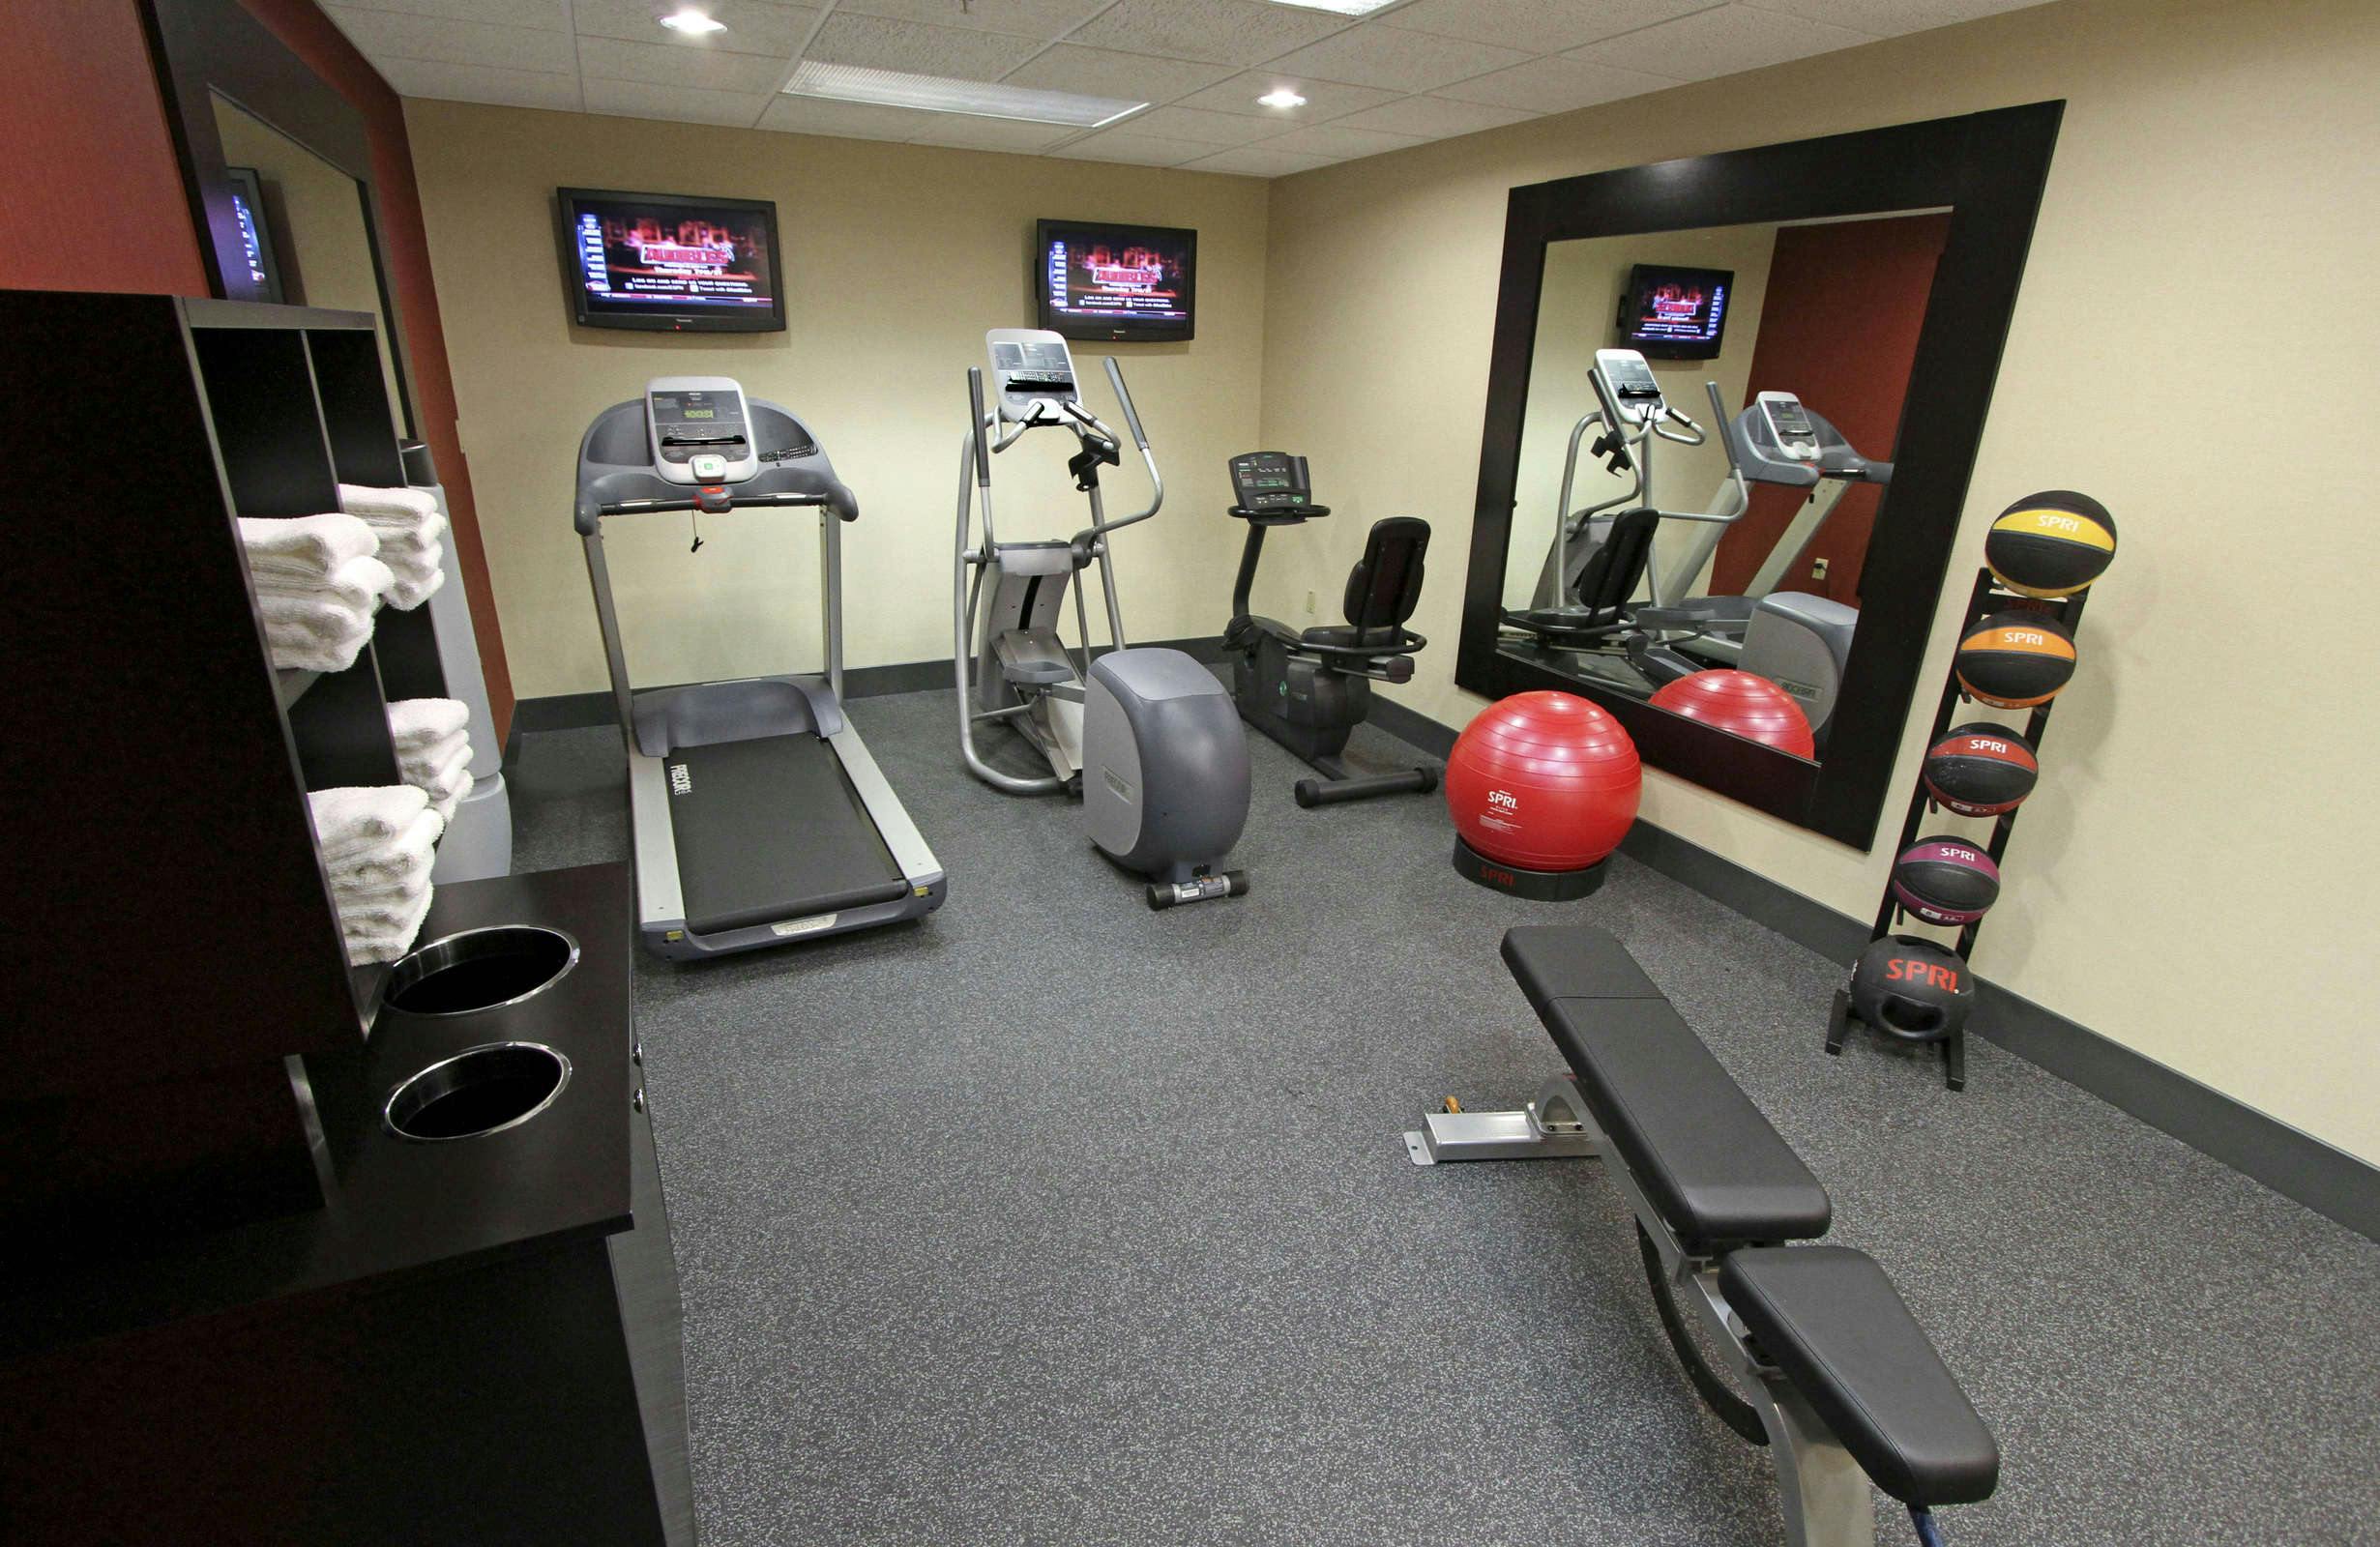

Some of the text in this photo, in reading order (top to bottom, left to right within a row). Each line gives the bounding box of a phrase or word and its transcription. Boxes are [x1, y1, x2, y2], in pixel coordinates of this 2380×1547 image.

[2037, 514, 2080, 534] SPRI
[2004, 631, 2042, 646] SPRI
[1969, 739, 2007, 754] SPRI
[1487, 790, 1517, 809] SPRI
[1941, 846, 1976, 862] SPRI
[1480, 865, 1515, 888] SPRI
[1887, 959, 1958, 993] SPRI
